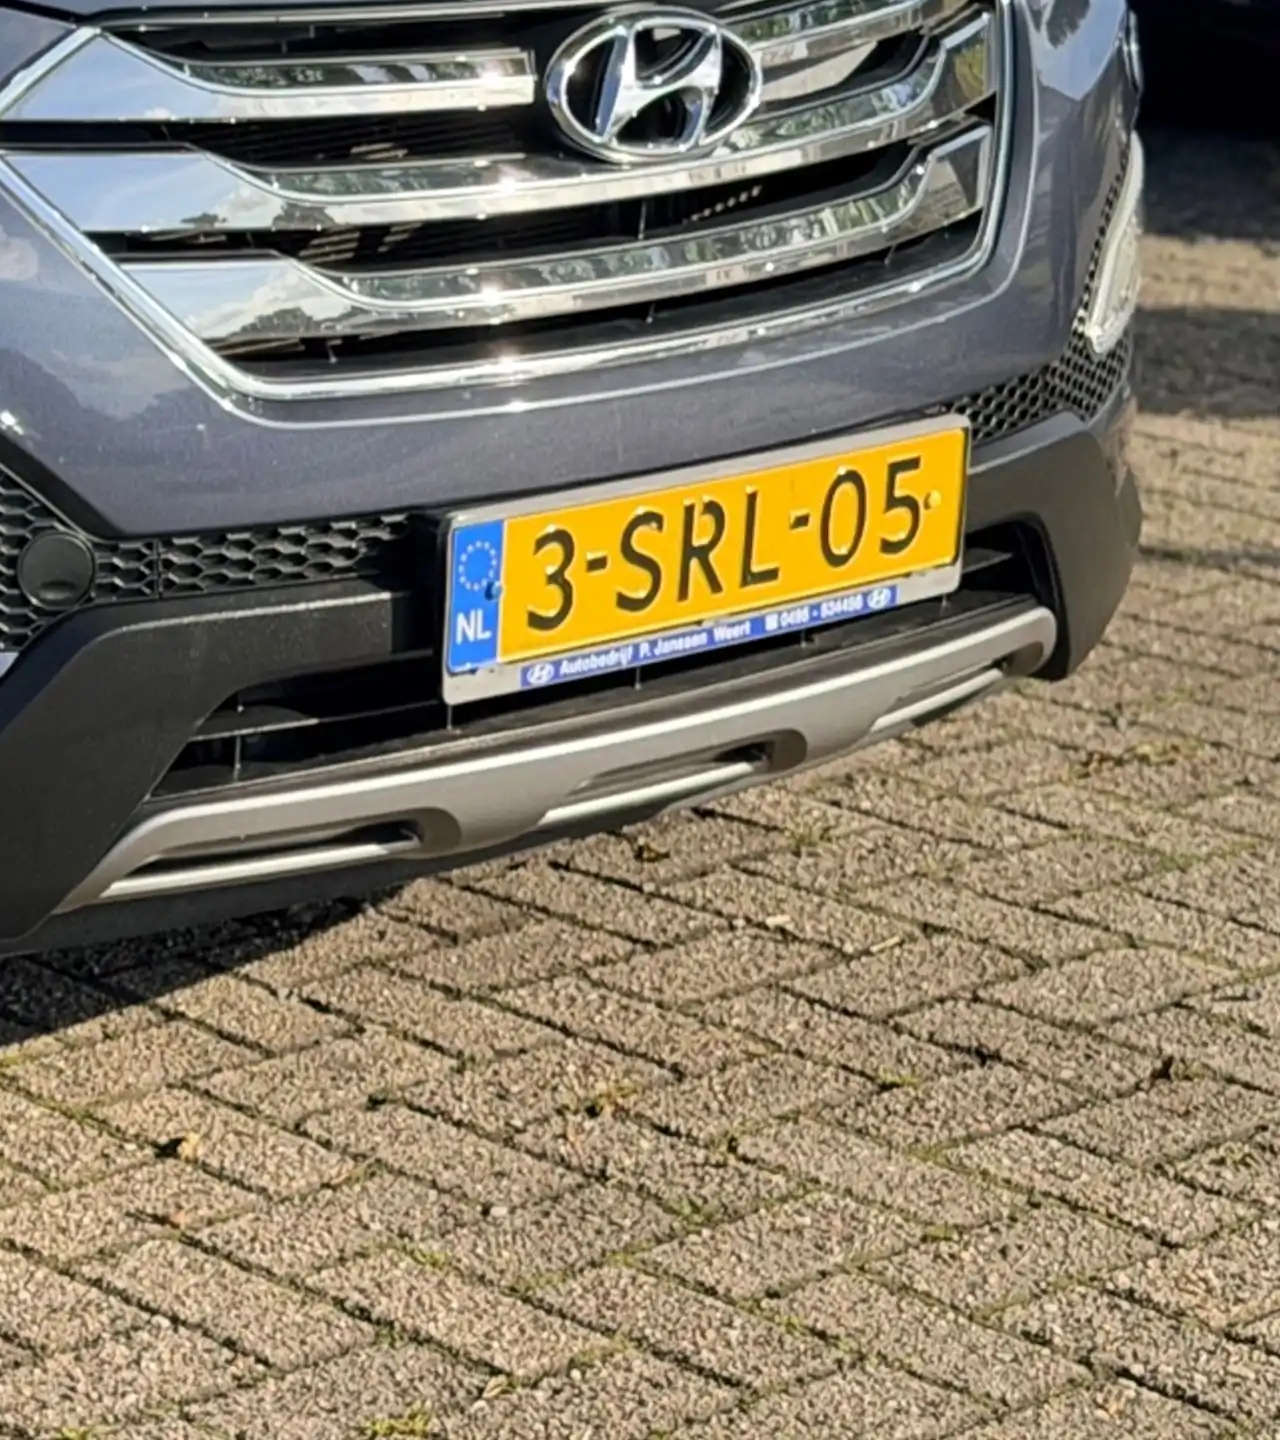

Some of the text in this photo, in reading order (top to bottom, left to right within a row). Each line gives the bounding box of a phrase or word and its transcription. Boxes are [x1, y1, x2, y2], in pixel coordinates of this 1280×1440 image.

[527, 457, 921, 631] 3-SRL-05
[456, 609, 492, 645] NL
[559, 644, 634, 672] Autobedrijf
[713, 620, 751, 643] Weert
